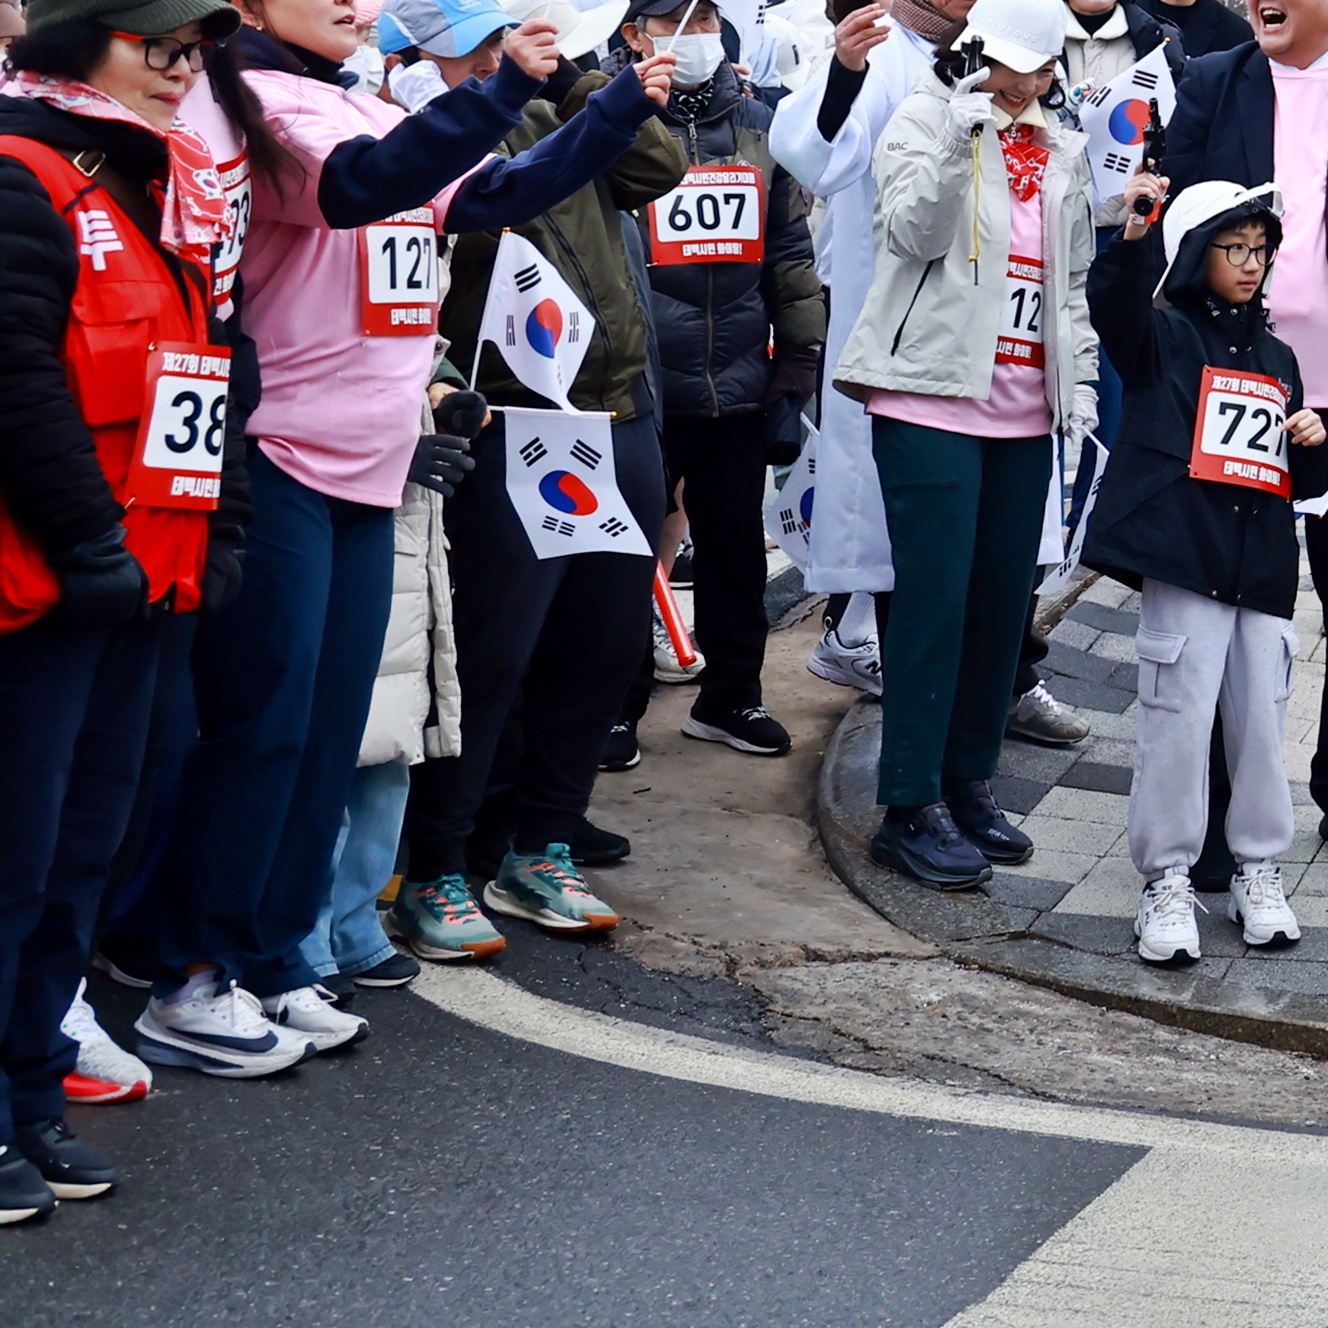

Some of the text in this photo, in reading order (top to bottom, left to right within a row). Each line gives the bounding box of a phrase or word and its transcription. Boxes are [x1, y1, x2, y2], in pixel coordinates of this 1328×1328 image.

[887, 142, 908, 151] BAC
[668, 193, 746, 232] 607
[78, 209, 124, 271] 투
[682, 243, 716, 256] 태백시민
[382, 236, 431, 290] 127
[162, 352, 200, 374] 제27회
[1212, 375, 1241, 393] 제27회
[164, 390, 226, 457] 38
[1217, 401, 1285, 458] 727
[1223, 460, 1259, 479] 태백시민
